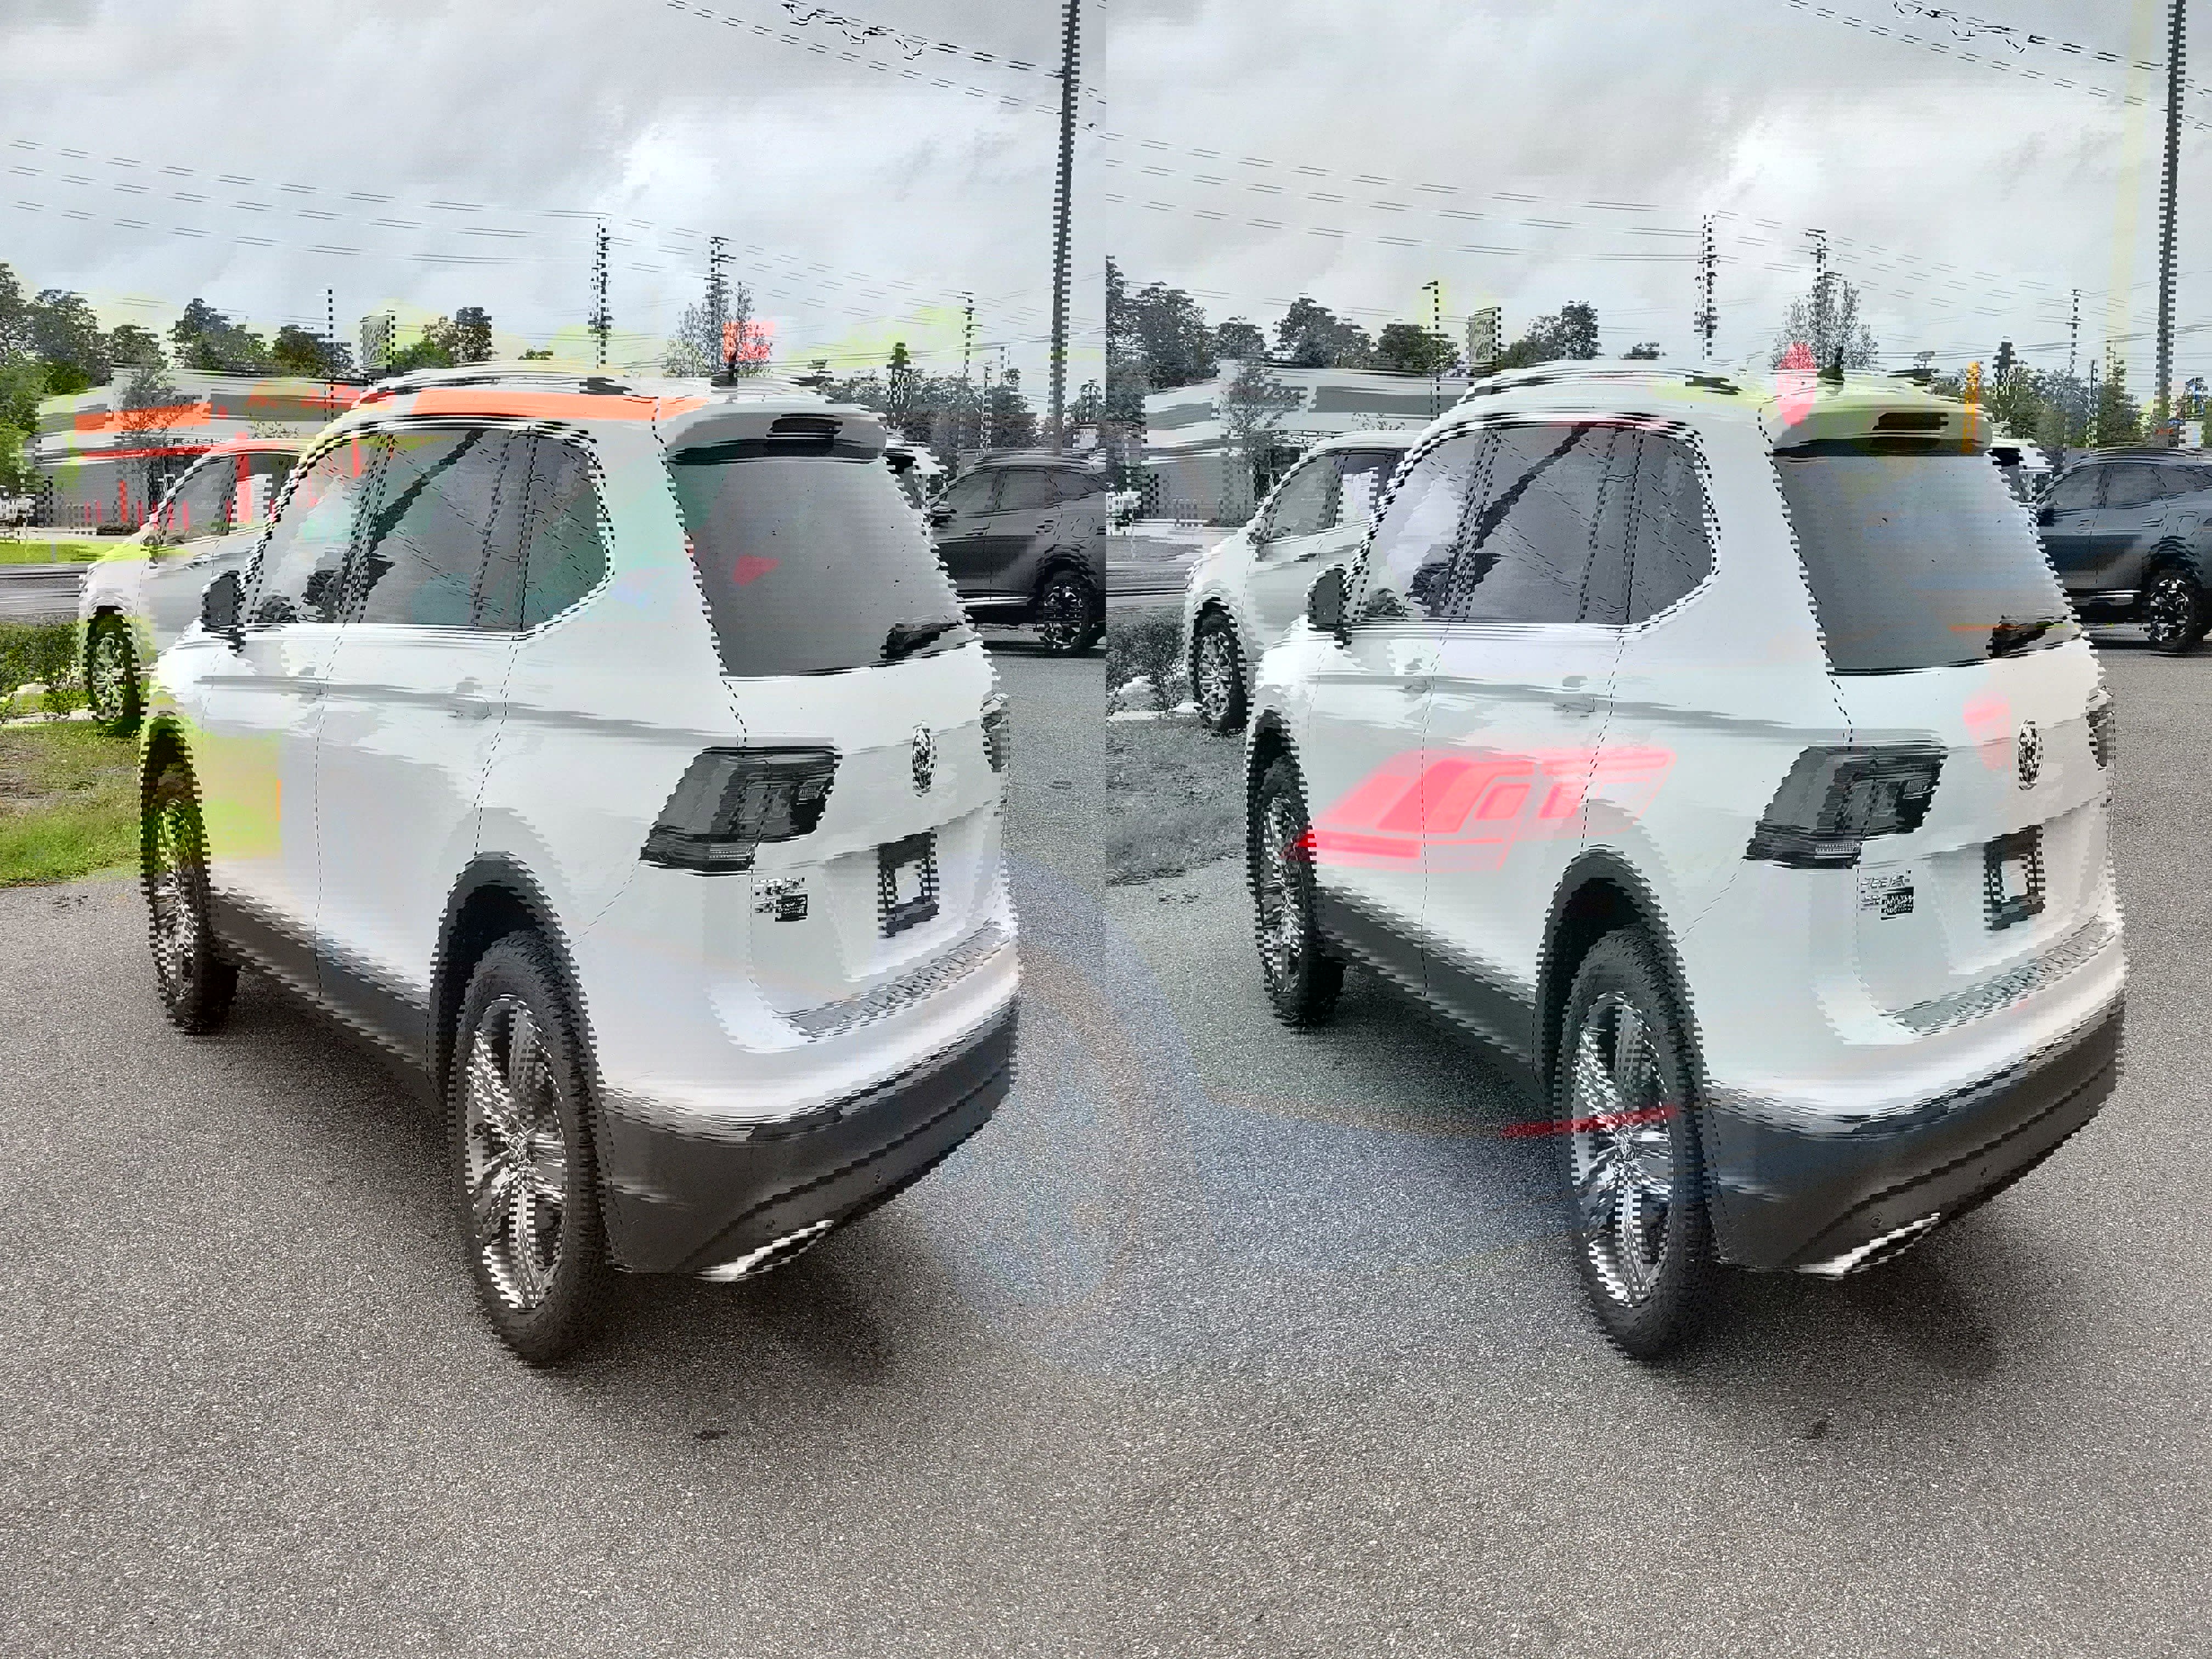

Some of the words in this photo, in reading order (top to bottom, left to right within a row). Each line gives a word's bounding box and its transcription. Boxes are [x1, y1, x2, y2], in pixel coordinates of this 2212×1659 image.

[1779, 367, 1814, 402] STOP
[1514, 874, 1605, 894] TIGUAN
[1513, 896, 1553, 911] SEL
